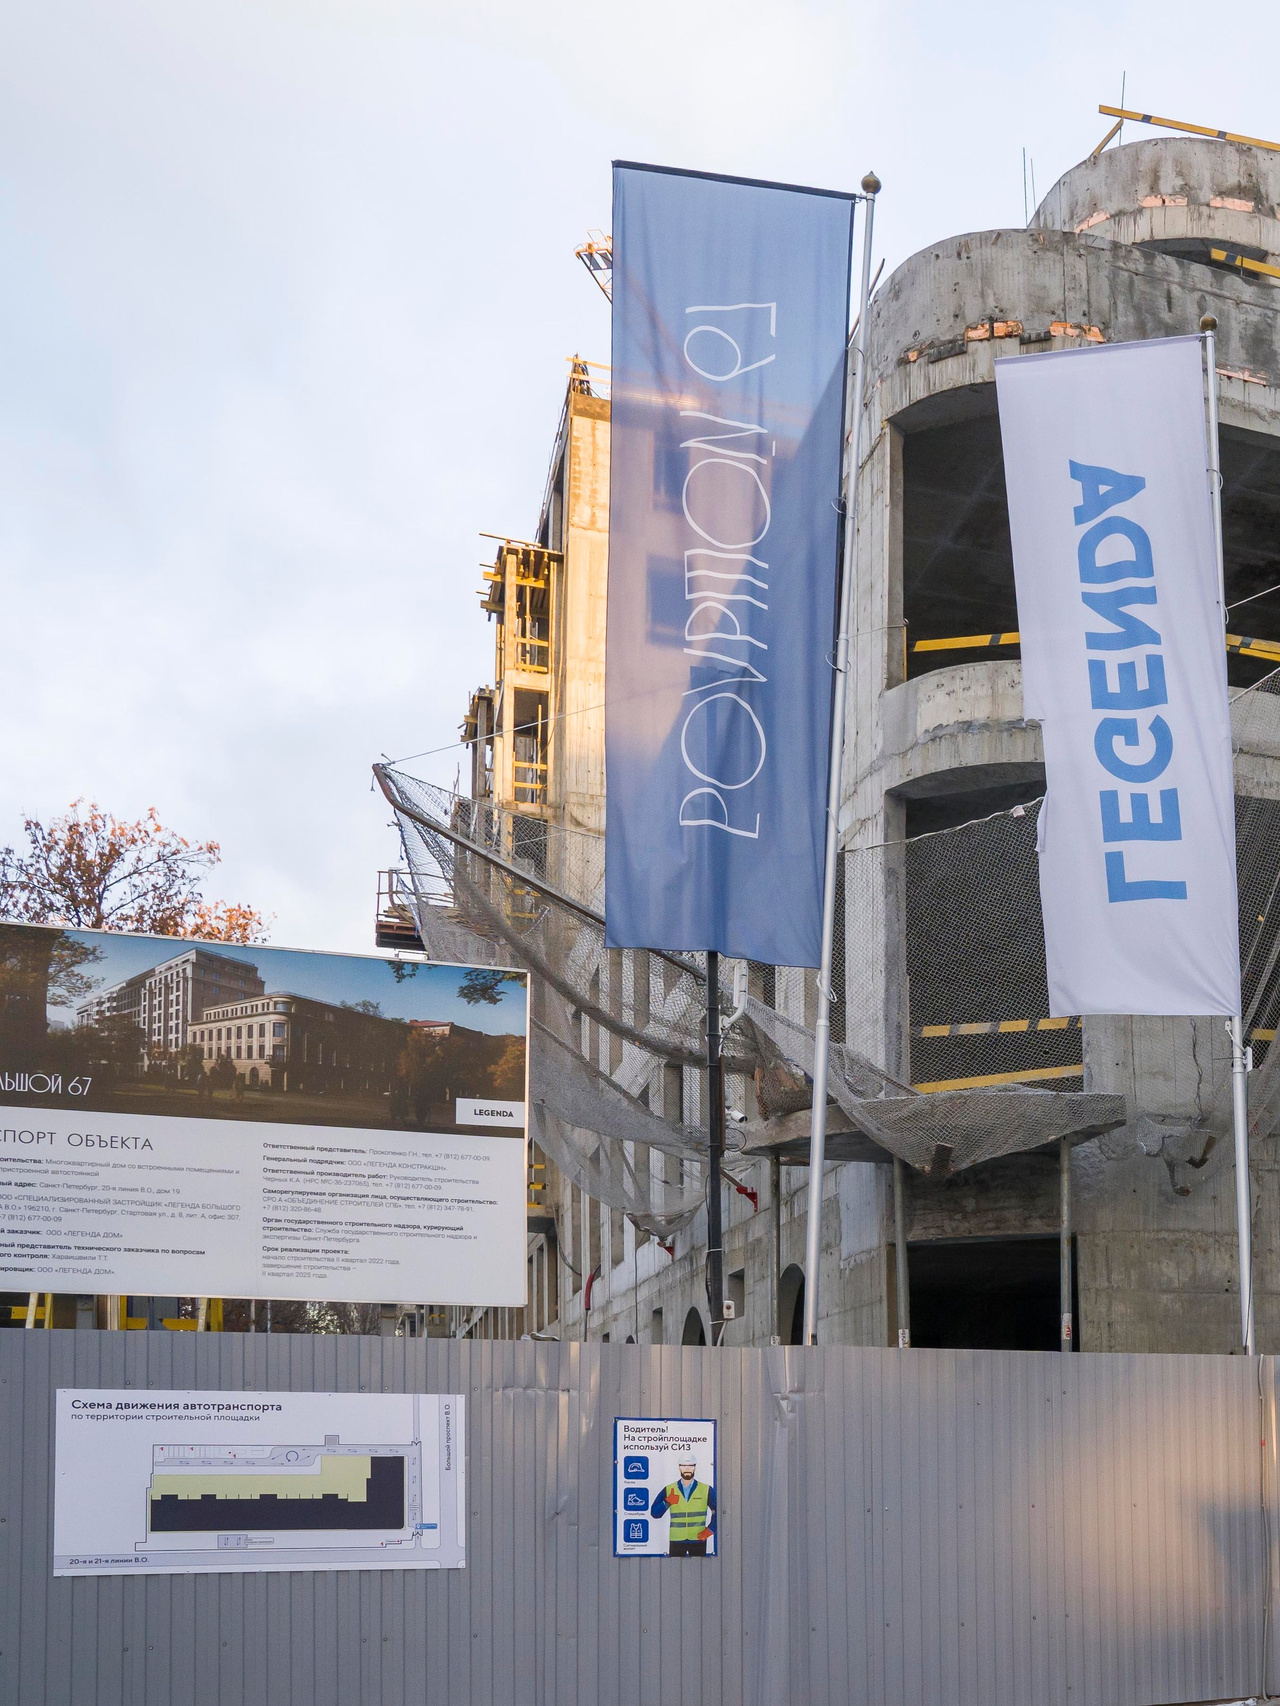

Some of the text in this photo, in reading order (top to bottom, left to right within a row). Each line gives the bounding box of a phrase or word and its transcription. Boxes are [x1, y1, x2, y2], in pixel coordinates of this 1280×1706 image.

[68, 1076, 92, 1095] 67
[474, 1108, 514, 1118] LEGENDA
[0, 1129, 153, 1151] ПОРТ ОБЪЕКТА
[262, 1142, 316, 1151] Ответственный
[316, 1146, 368, 1154] представитель:
[368, 1148, 408, 1157] Прокопенко
[262, 1155, 308, 1163] Генеральный
[308, 1158, 346, 1166] подрядчик:
[363, 1160, 397, 1168] «ЛЕГЕНДА
[46, 1159, 110, 1168] Многоквартирный
[138, 1164, 184, 1172] встроенными
[186, 1166, 234, 1175] помещениями
[262, 1167, 314, 1176] Ответственный
[316, 1170, 366, 1178] производитель
[390, 1174, 433, 1182] Руководитель
[394, 1182, 410, 1190] (812)
[262, 1188, 326, 1197] Саморегулируемая
[328, 1191, 370, 1200] организация
[390, 1195, 450, 1204] осуществляющего
[450, 1198, 498, 1206] строительство:
[112, 1198, 162, 1208] ЗАСТРОЙЩИК
[164, 1201, 200, 1210] «ЛЕГЕНДА
[202, 1202, 241, 1211] БОЛЬШОГО
[272, 1205, 289, 1213] (812)
[284, 1197, 339, 1206] «ОБЪЕДИНЕНИЕ
[340, 1200, 384, 1208] СТРОИТЕЛЕЙ
[426, 1204, 443, 1212] (812)
[8, 1213, 26, 1221] (812)
[27, 1214, 63, 1222] 677-00-09
[120, 1209, 157, 1218] Стартовая
[262, 1216, 282, 1224] Орган
[284, 1218, 344, 1226] государственного
[6, 1228, 42, 1236] заказчик:
[64, 1230, 101, 1238] «ЛЕГЕНДА
[340, 1228, 399, 1237] государственного
[400, 1231, 446, 1239] строительного
[262, 1234, 301, 1242] экспертизы
[16, 1243, 72, 1251] представитель
[262, 1245, 279, 1253] Срок
[286, 1255, 335, 1263] строительства
[54, 1267, 93, 1275] «ЛЕГЕНДА
[304, 1264, 351, 1272] строительства
[71, 1400, 282, 1413] Схема движения автотранспорта
[86, 1413, 143, 1421] территории
[145, 1413, 212, 1421] строительной
[623, 1425, 669, 1433] Водитель!
[623, 1434, 707, 1443] На стройплощадке
[623, 1443, 691, 1452] используй СИЗ
